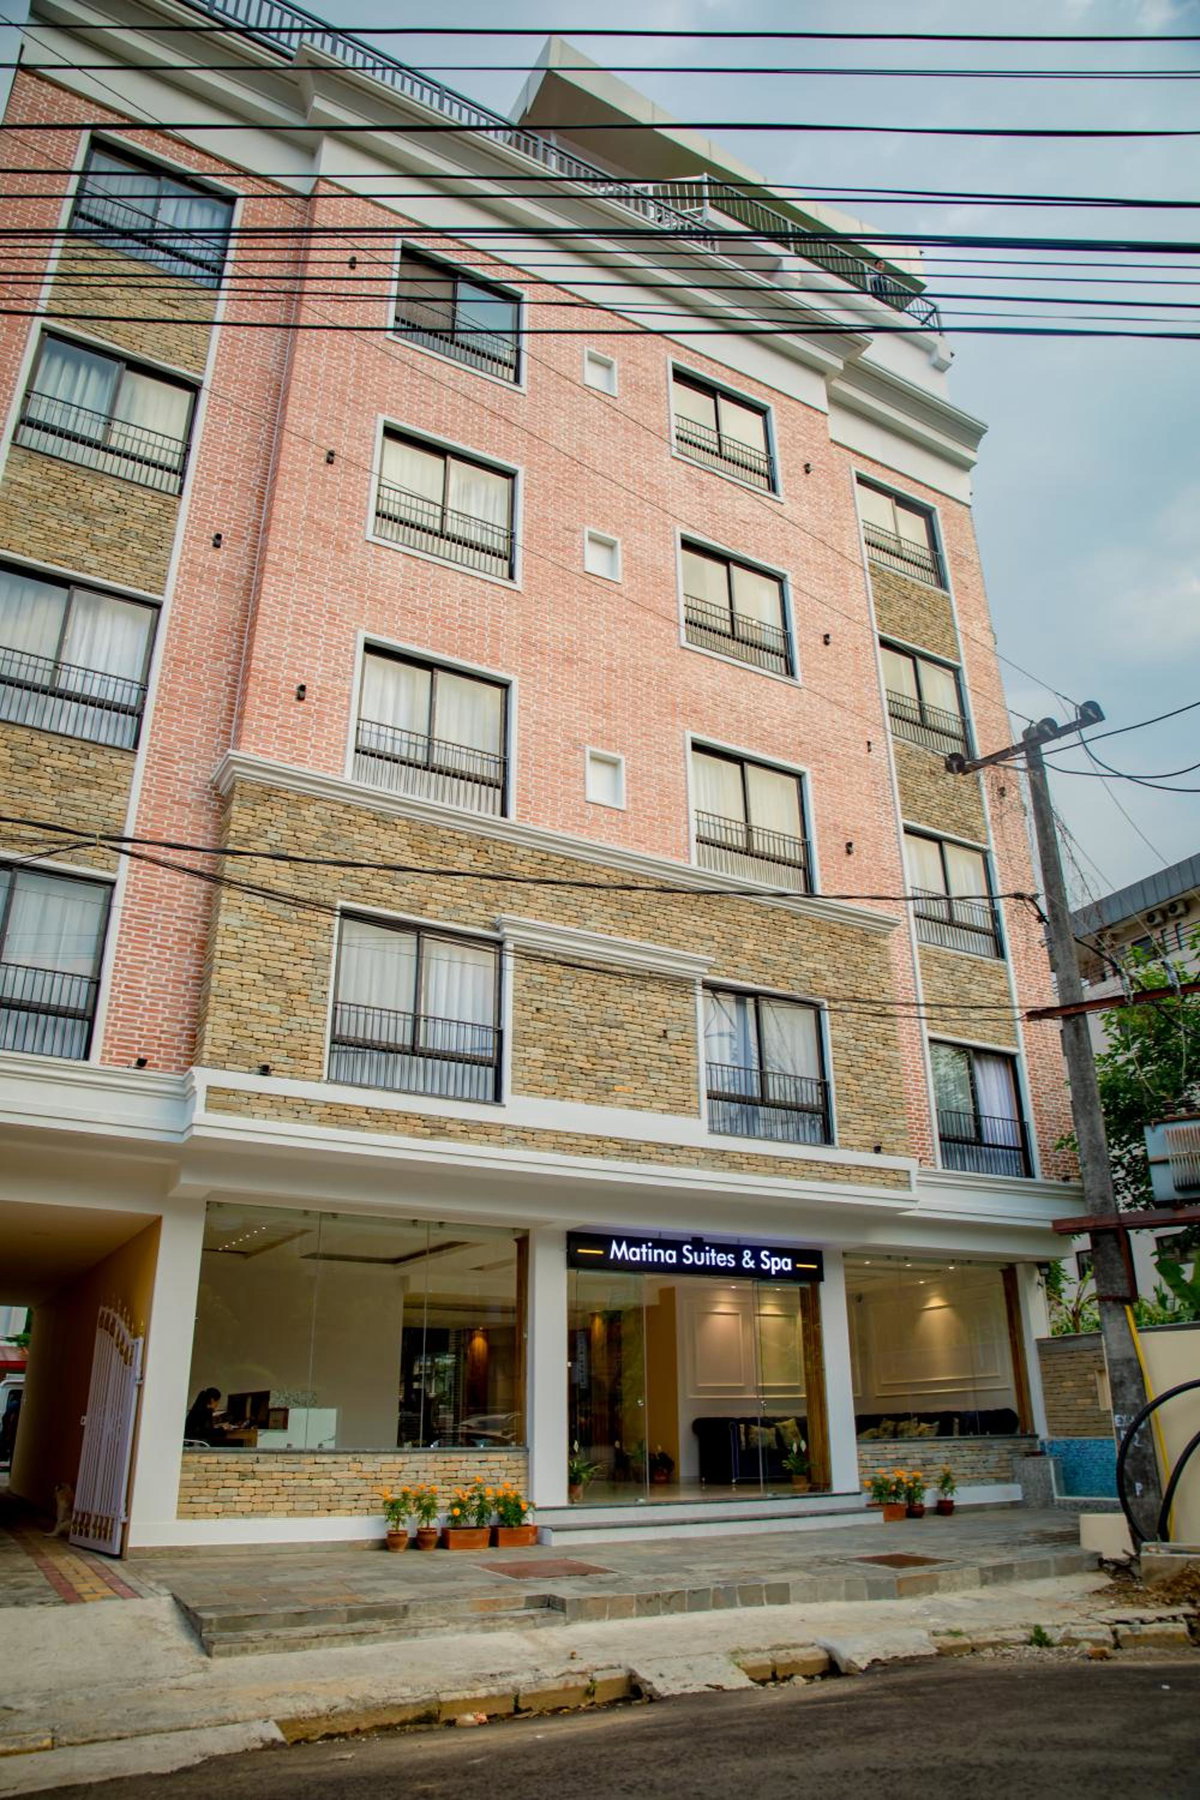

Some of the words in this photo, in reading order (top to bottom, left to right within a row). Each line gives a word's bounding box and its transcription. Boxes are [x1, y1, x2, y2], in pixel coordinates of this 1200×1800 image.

[609, 1239, 677, 1264] Matina
[682, 1244, 736, 1267] Suites
[741, 1250, 756, 1268] &
[760, 1250, 792, 1275] Spa
